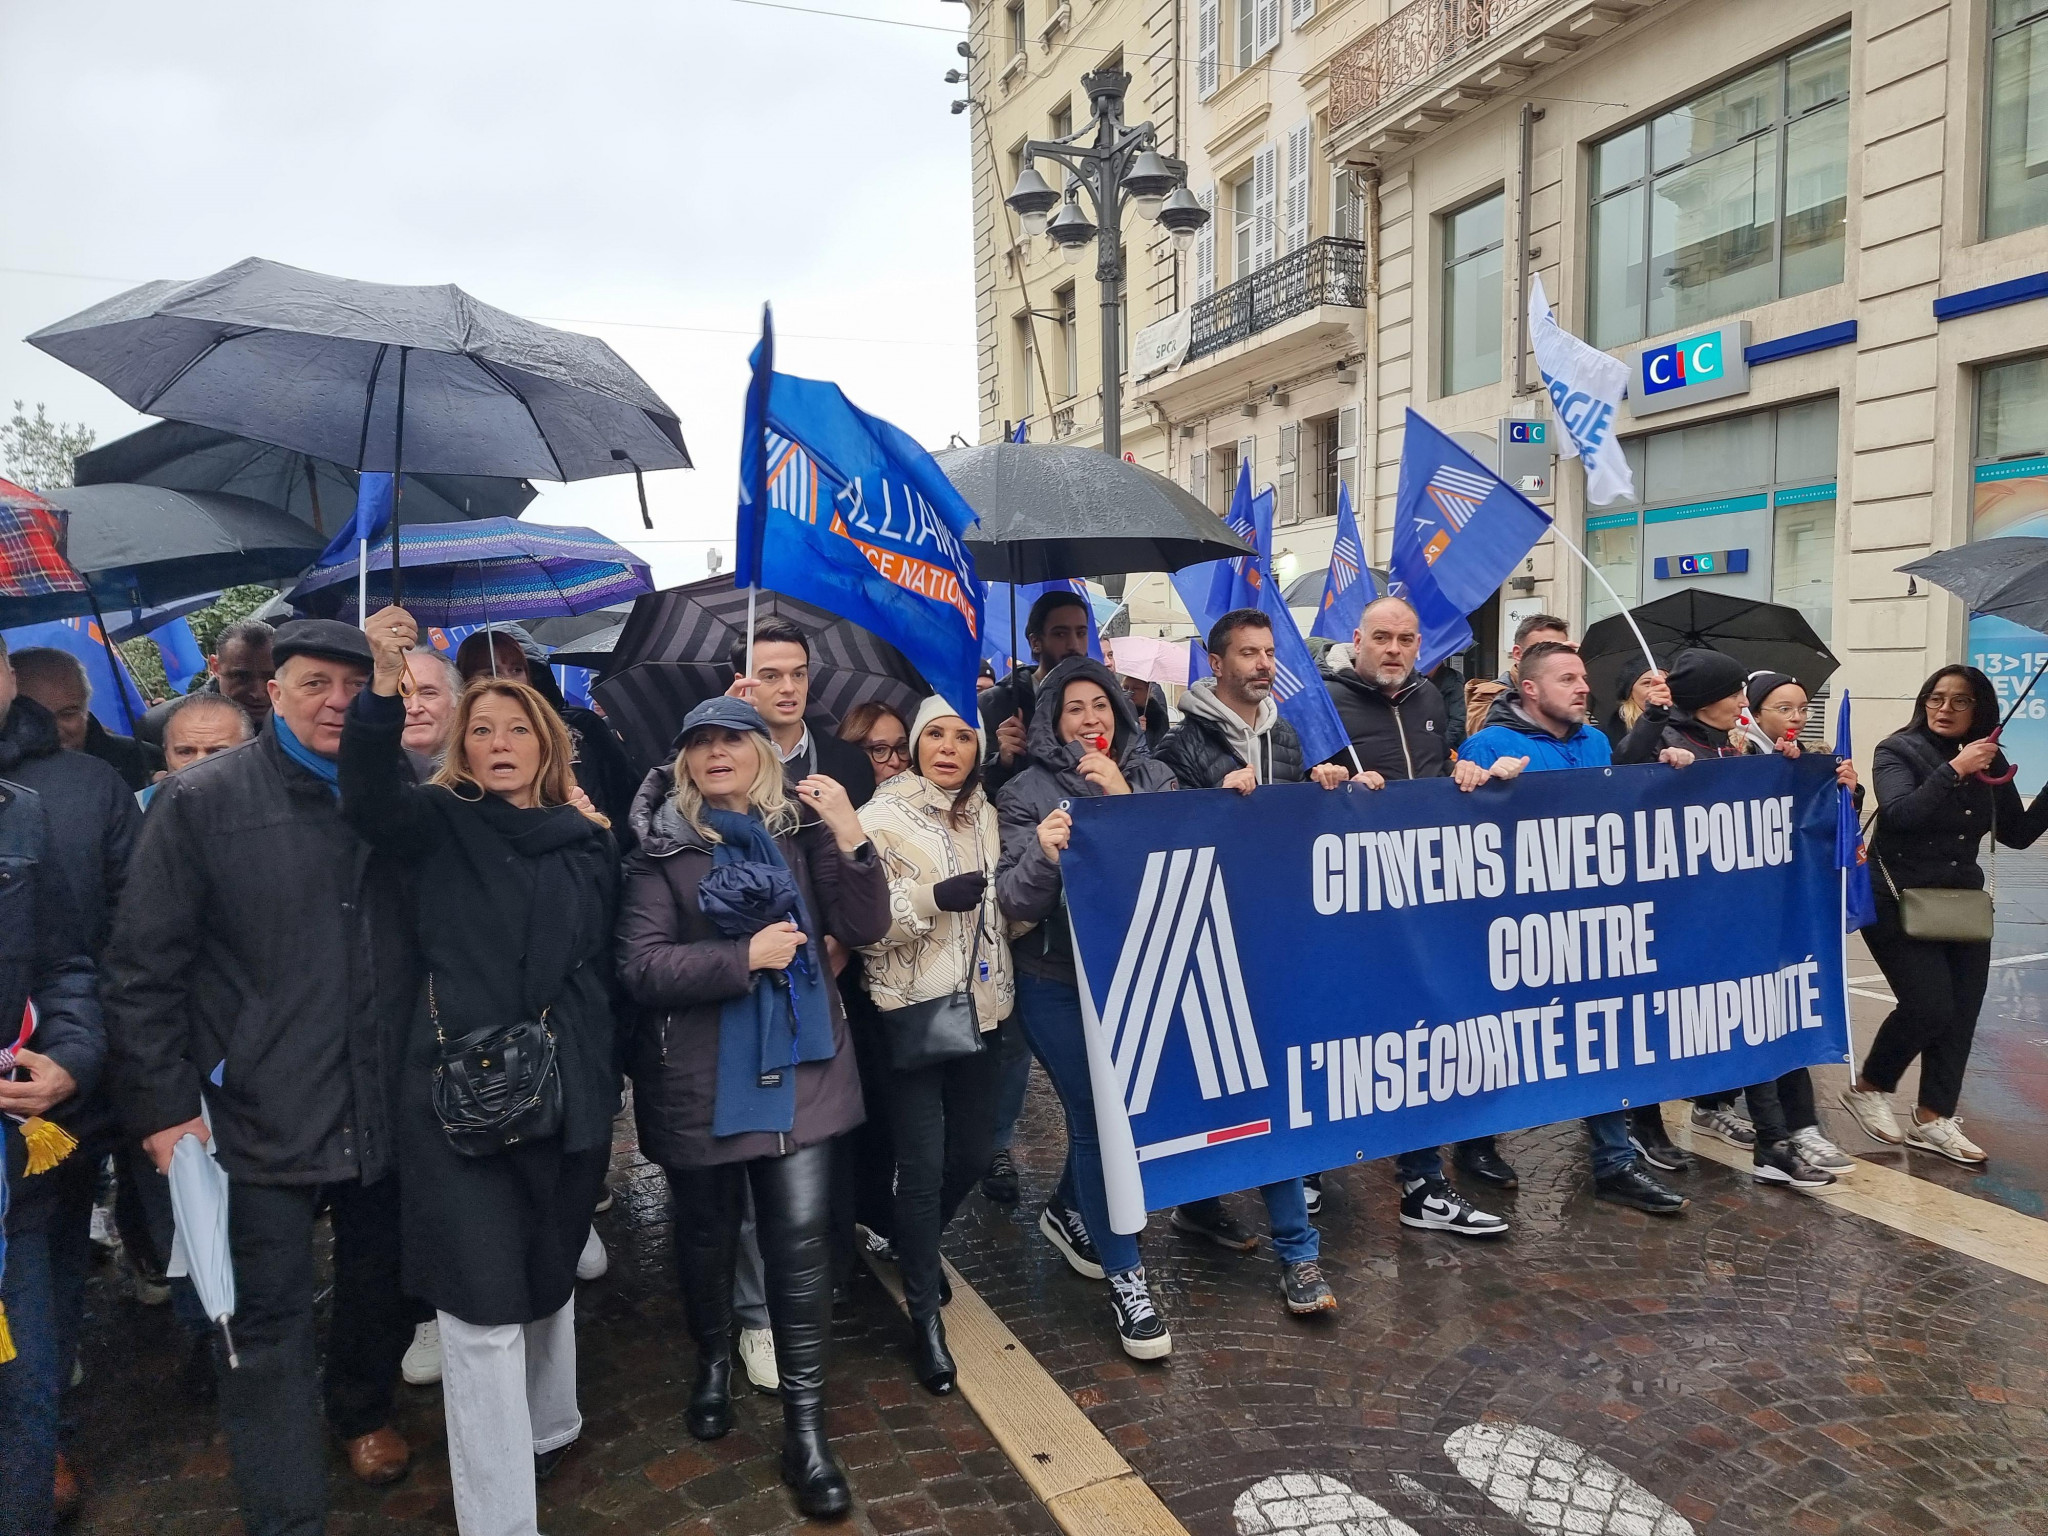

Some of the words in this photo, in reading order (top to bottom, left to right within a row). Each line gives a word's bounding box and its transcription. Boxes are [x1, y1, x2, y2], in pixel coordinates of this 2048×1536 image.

[1649, 342, 1715, 385] CIC
[1541, 370, 1614, 446] RGIE
[1512, 425, 1542, 440] CIC
[1525, 557, 1534, 572] 5
[1682, 557, 1711, 571] CIC
[1987, 675, 2036, 697] EV.
[1997, 698, 2047, 720] 026
[1312, 822, 1507, 916] CITOYENS
[1515, 812, 1626, 895] AVEC
[1633, 807, 1680, 883] LA
[1683, 795, 1794, 877] POLICE
[1488, 901, 1658, 992] CONTRE
[1286, 997, 1568, 1130] L'INSÉCURITÉ
[1575, 996, 1624, 1075] ET
[1632, 954, 1823, 1066] L'IMPUNITÉ
